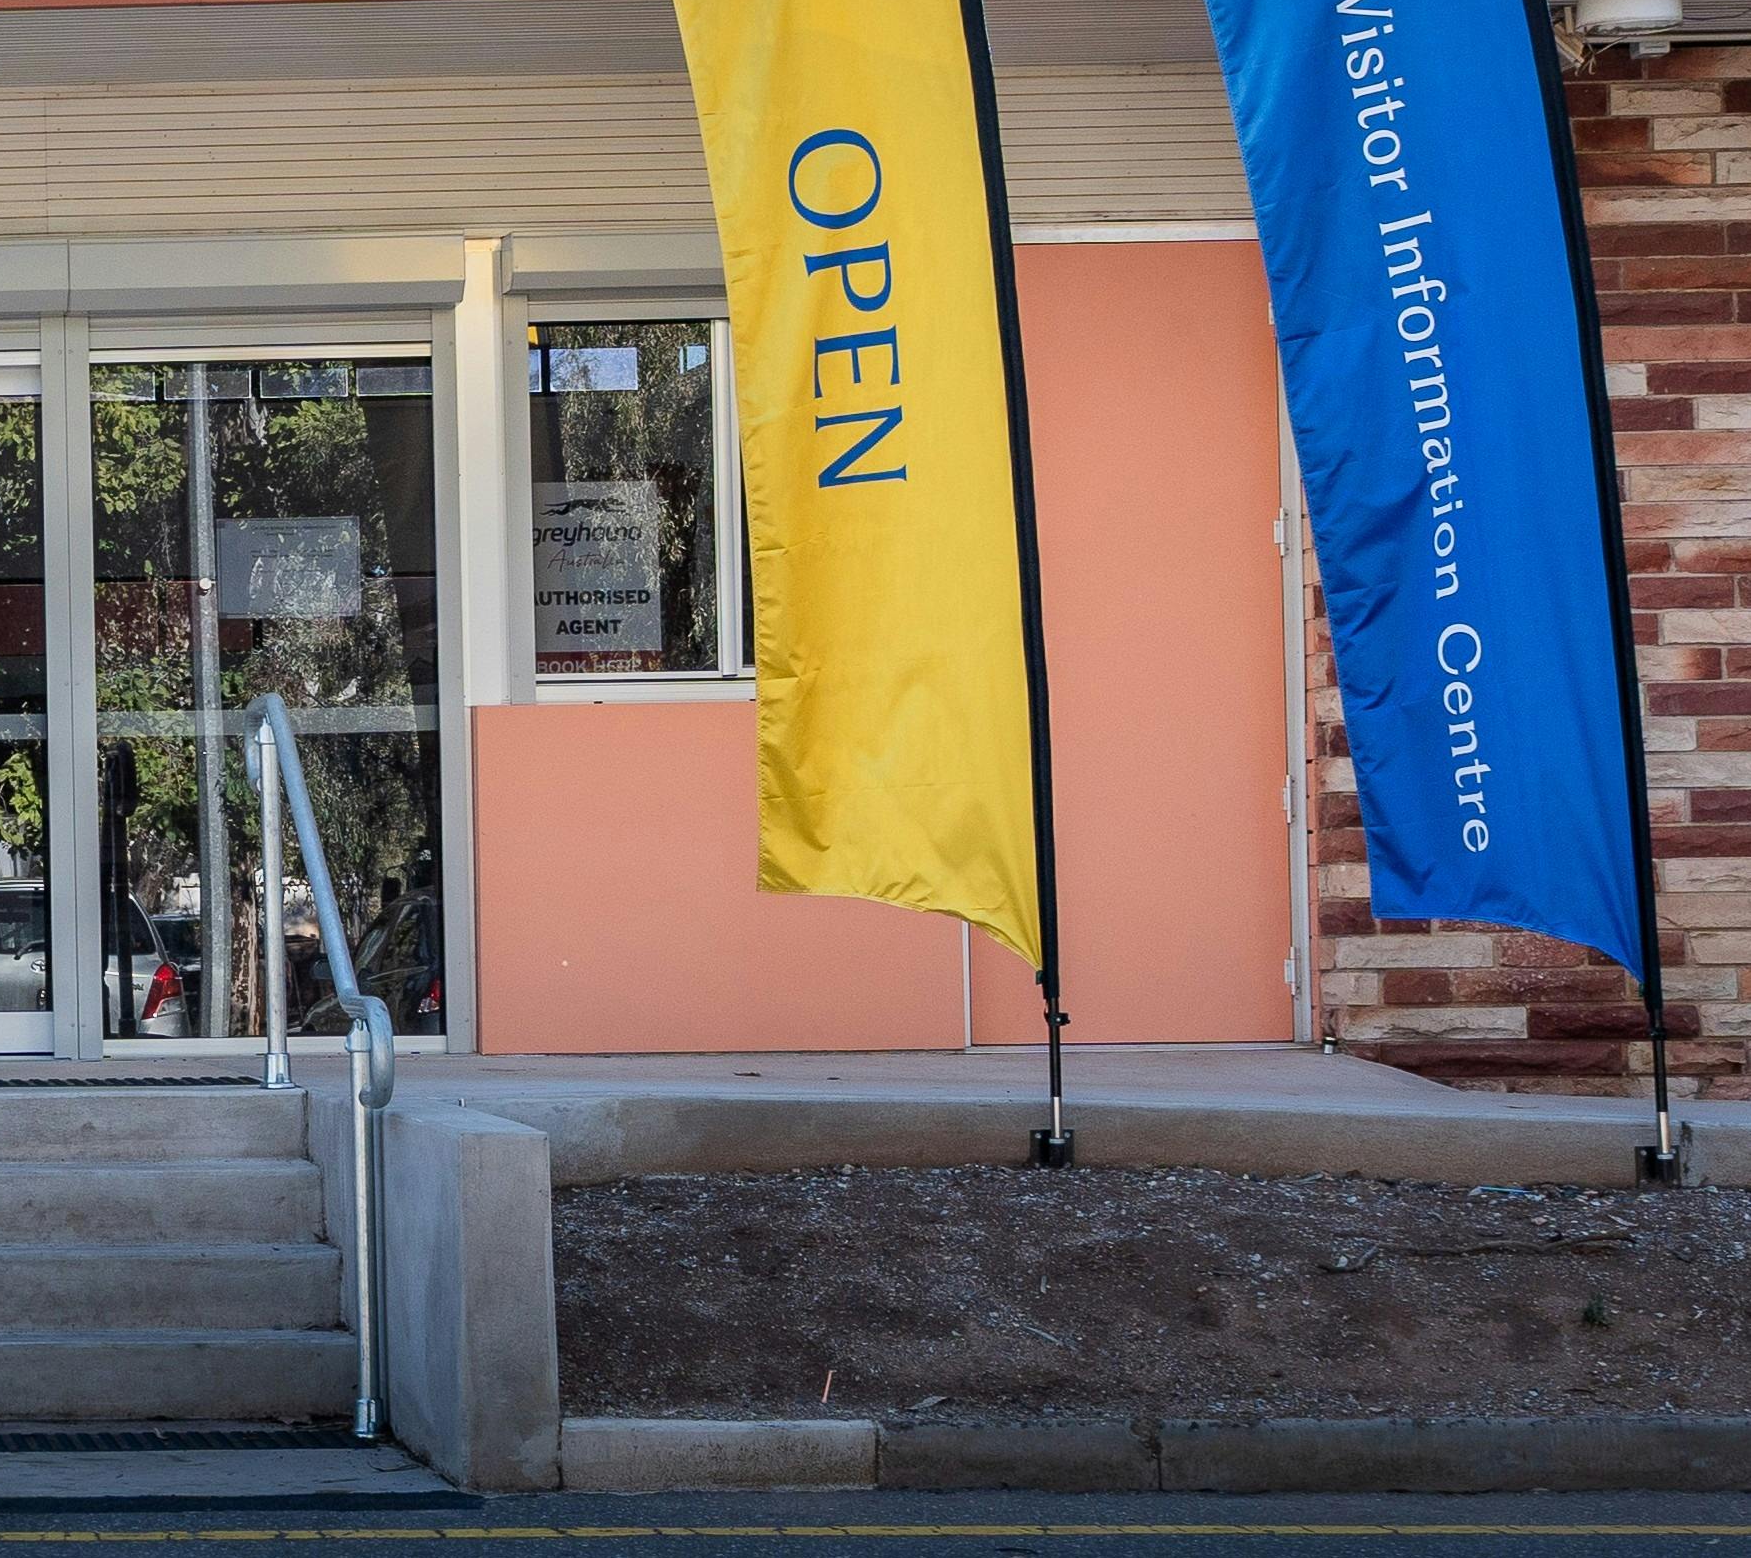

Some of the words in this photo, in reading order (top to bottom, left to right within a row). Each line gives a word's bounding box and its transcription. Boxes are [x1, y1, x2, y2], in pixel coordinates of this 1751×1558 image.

[790, 130, 907, 487] OPEN
[533, 521, 642, 546] greyhound
[1379, 211, 1459, 599] Information
[1438, 623, 1491, 853] Centre
[556, 619, 622, 635] AGENT
[537, 660, 586, 673] BOOK
